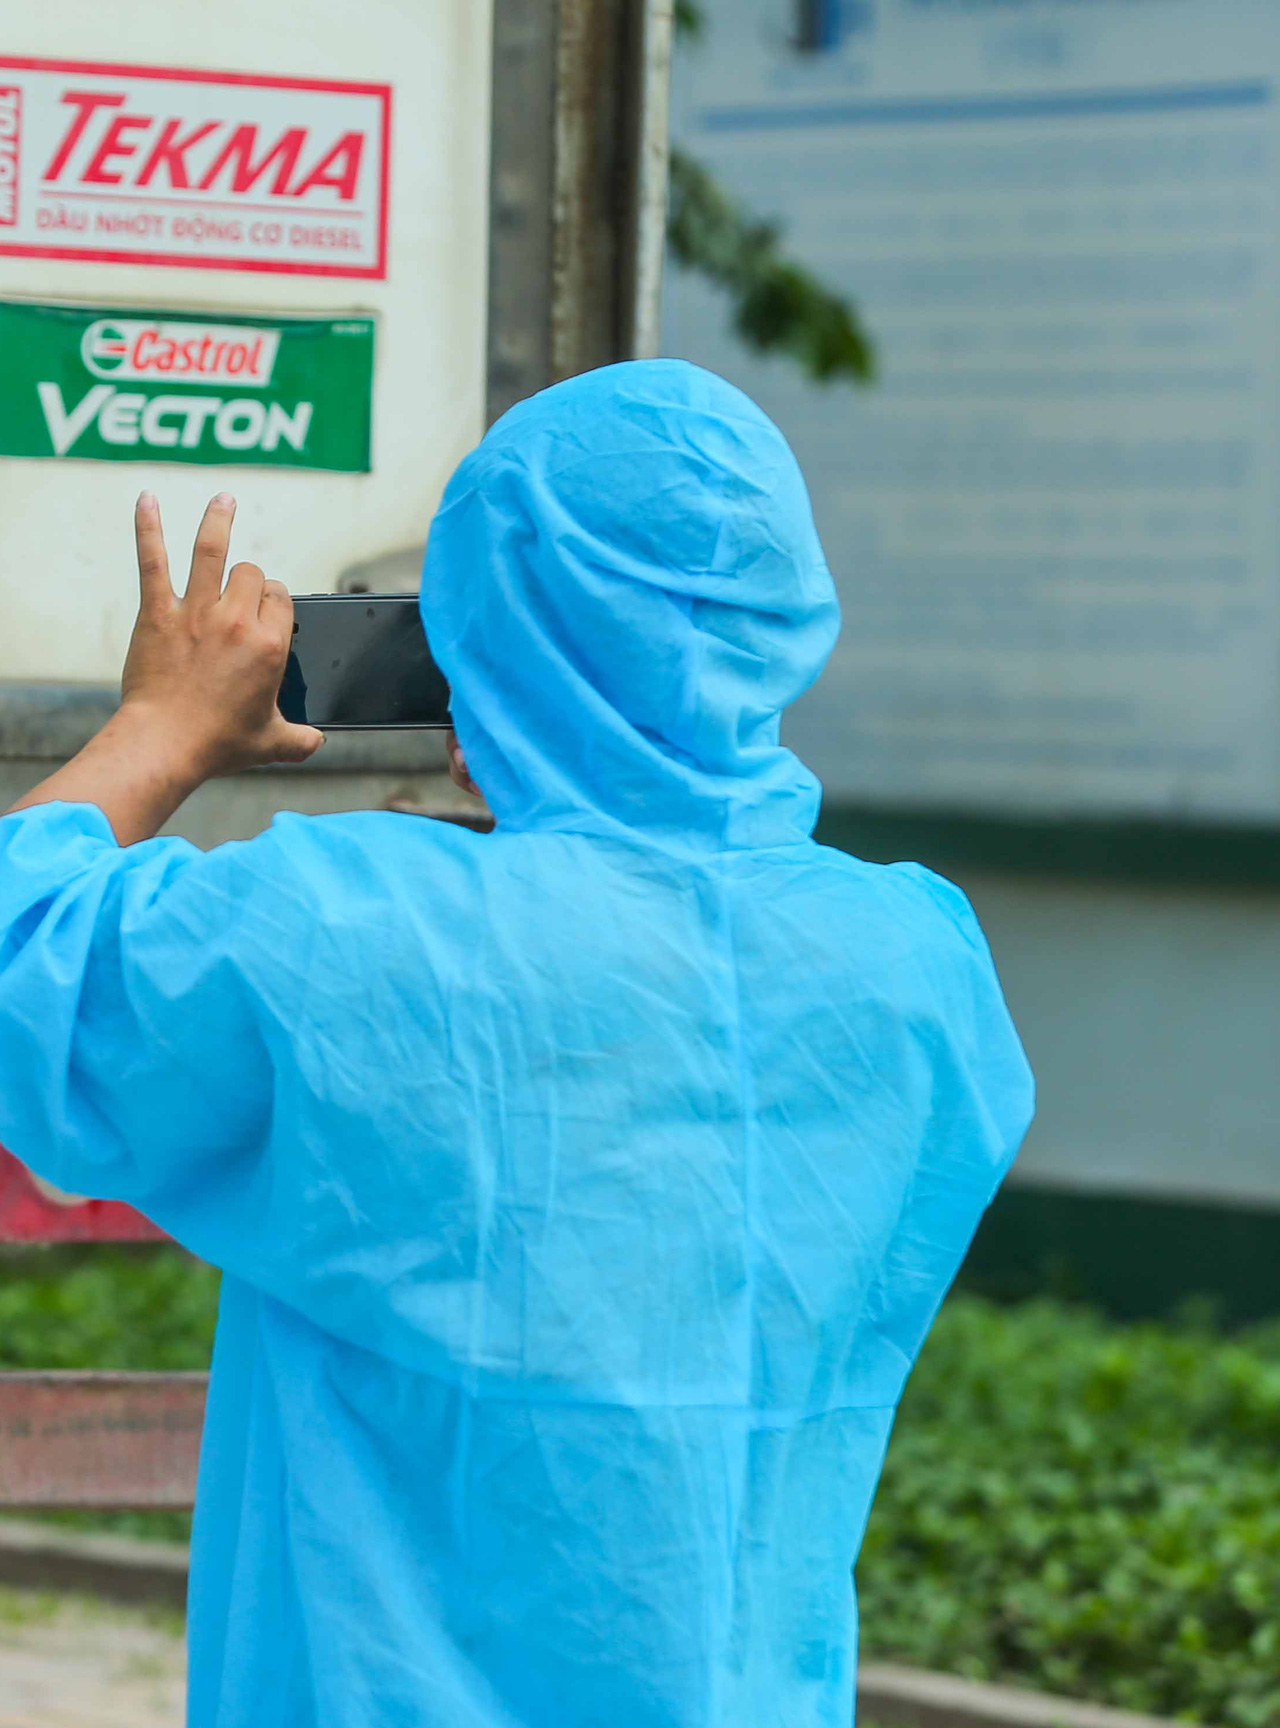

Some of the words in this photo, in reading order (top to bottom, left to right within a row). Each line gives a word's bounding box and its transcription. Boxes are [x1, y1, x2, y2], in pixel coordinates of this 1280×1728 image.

[41, 89, 366, 201] TEKMA
[290, 224, 362, 250] DIESEL
[131, 330, 264, 376] Castrol
[37, 382, 314, 456] VECTON
